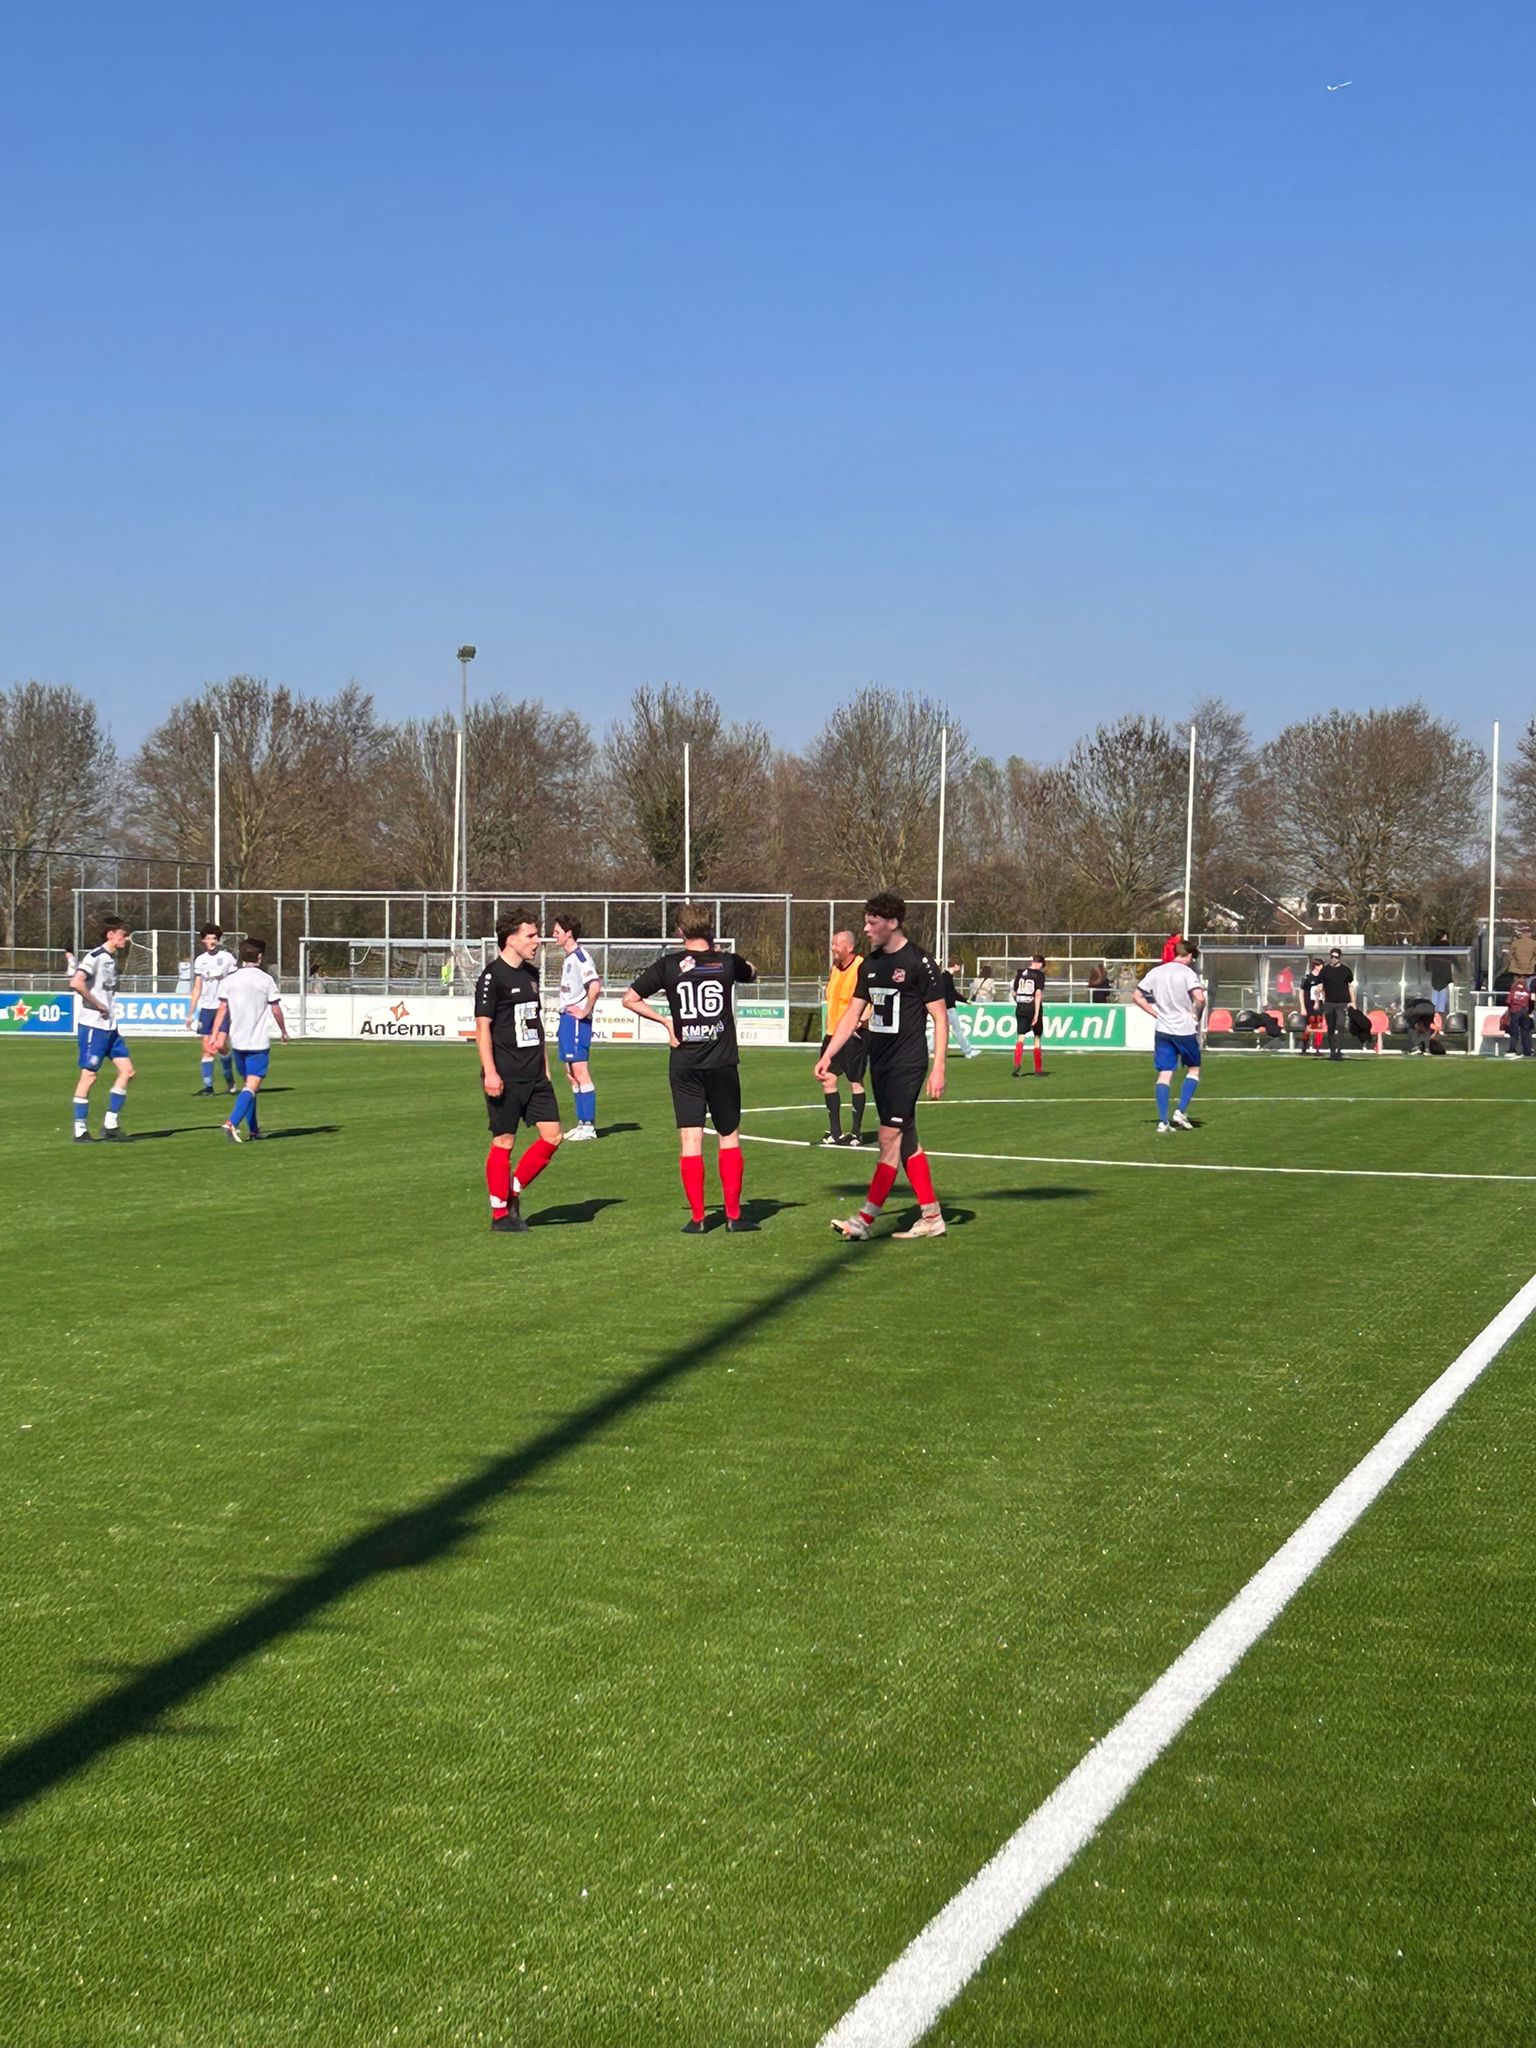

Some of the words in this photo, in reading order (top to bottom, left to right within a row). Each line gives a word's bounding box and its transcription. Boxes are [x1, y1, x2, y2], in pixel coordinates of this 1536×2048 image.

[676, 980, 724, 1019] 16
[114, 1003, 186, 1020] BEACH
[360, 1020, 446, 1037] Antenna
